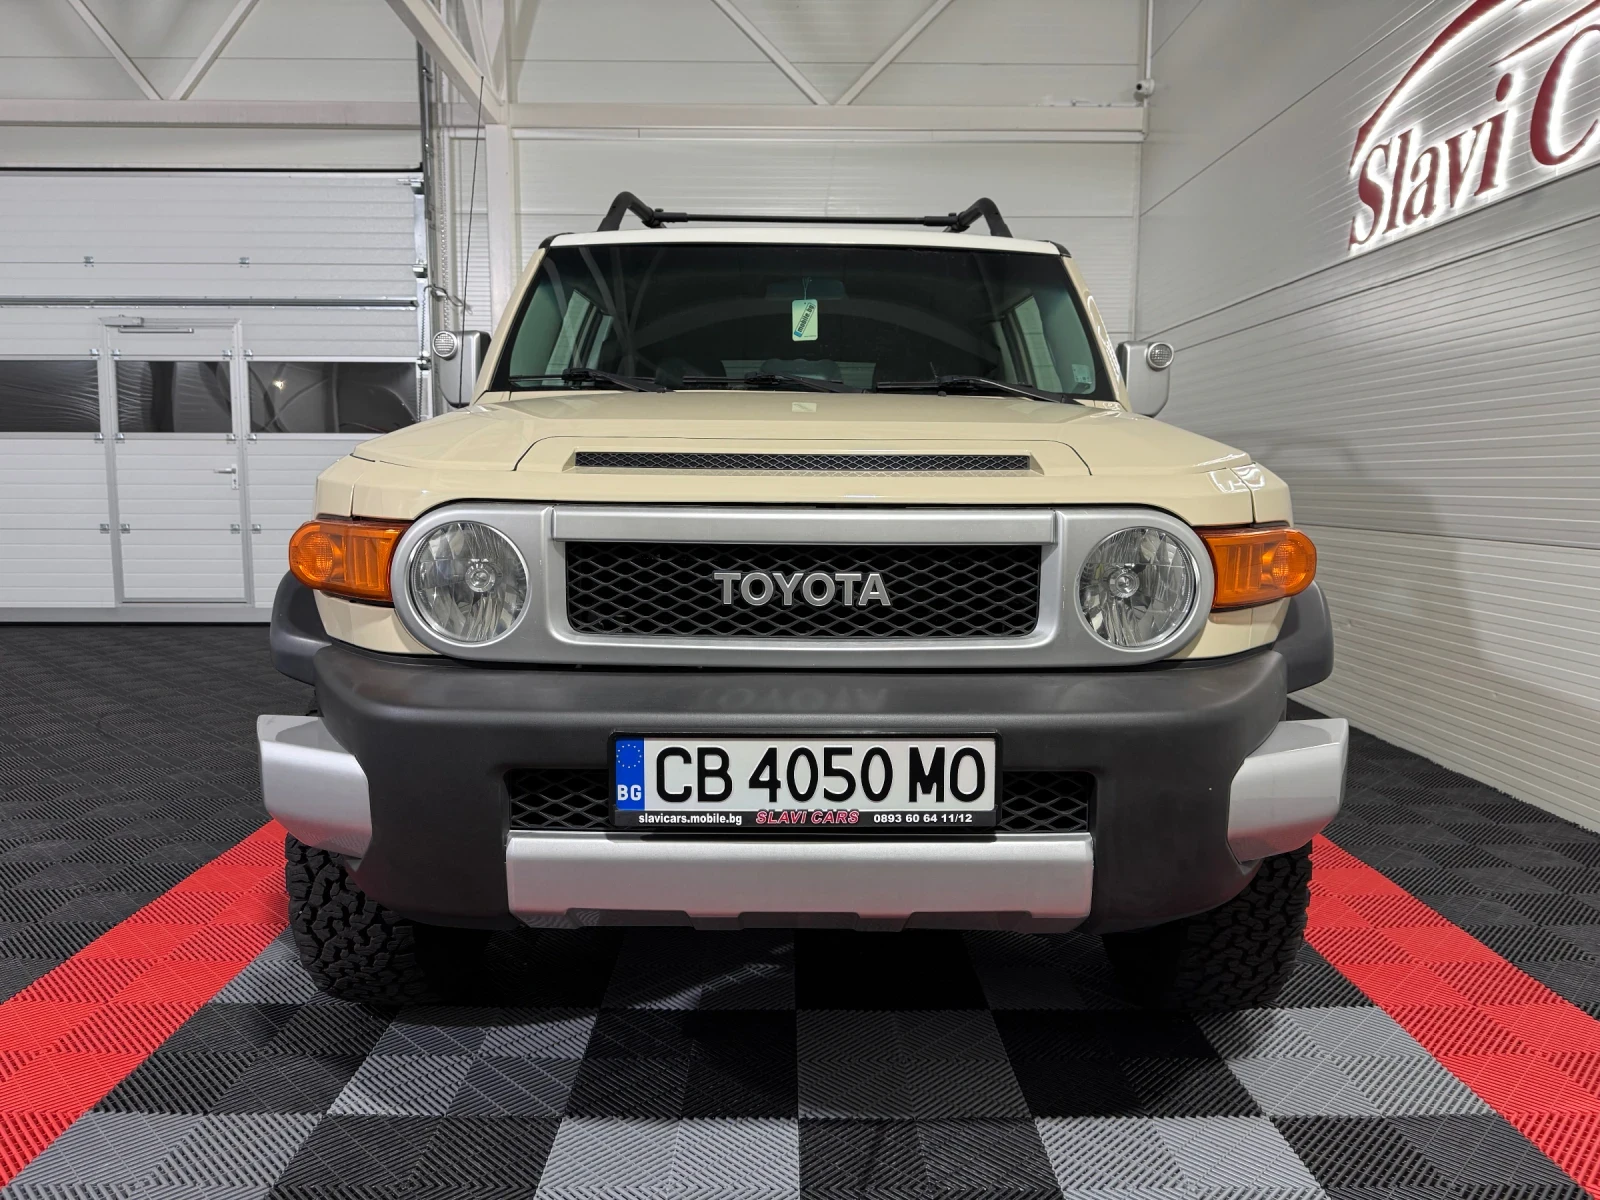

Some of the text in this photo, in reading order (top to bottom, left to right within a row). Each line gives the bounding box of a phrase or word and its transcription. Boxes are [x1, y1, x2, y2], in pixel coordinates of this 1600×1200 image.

[1348, 72, 1513, 250] Slavi
[713, 572, 891, 606] TOYOTA
[656, 747, 985, 803] CB 4050 MO
[617, 784, 642, 801] BG
[638, 813, 742, 825] slavicars.mobile.bg
[756, 810, 859, 824] SLAVI CARS
[873, 813, 973, 823] 0893 60 64 11/12
